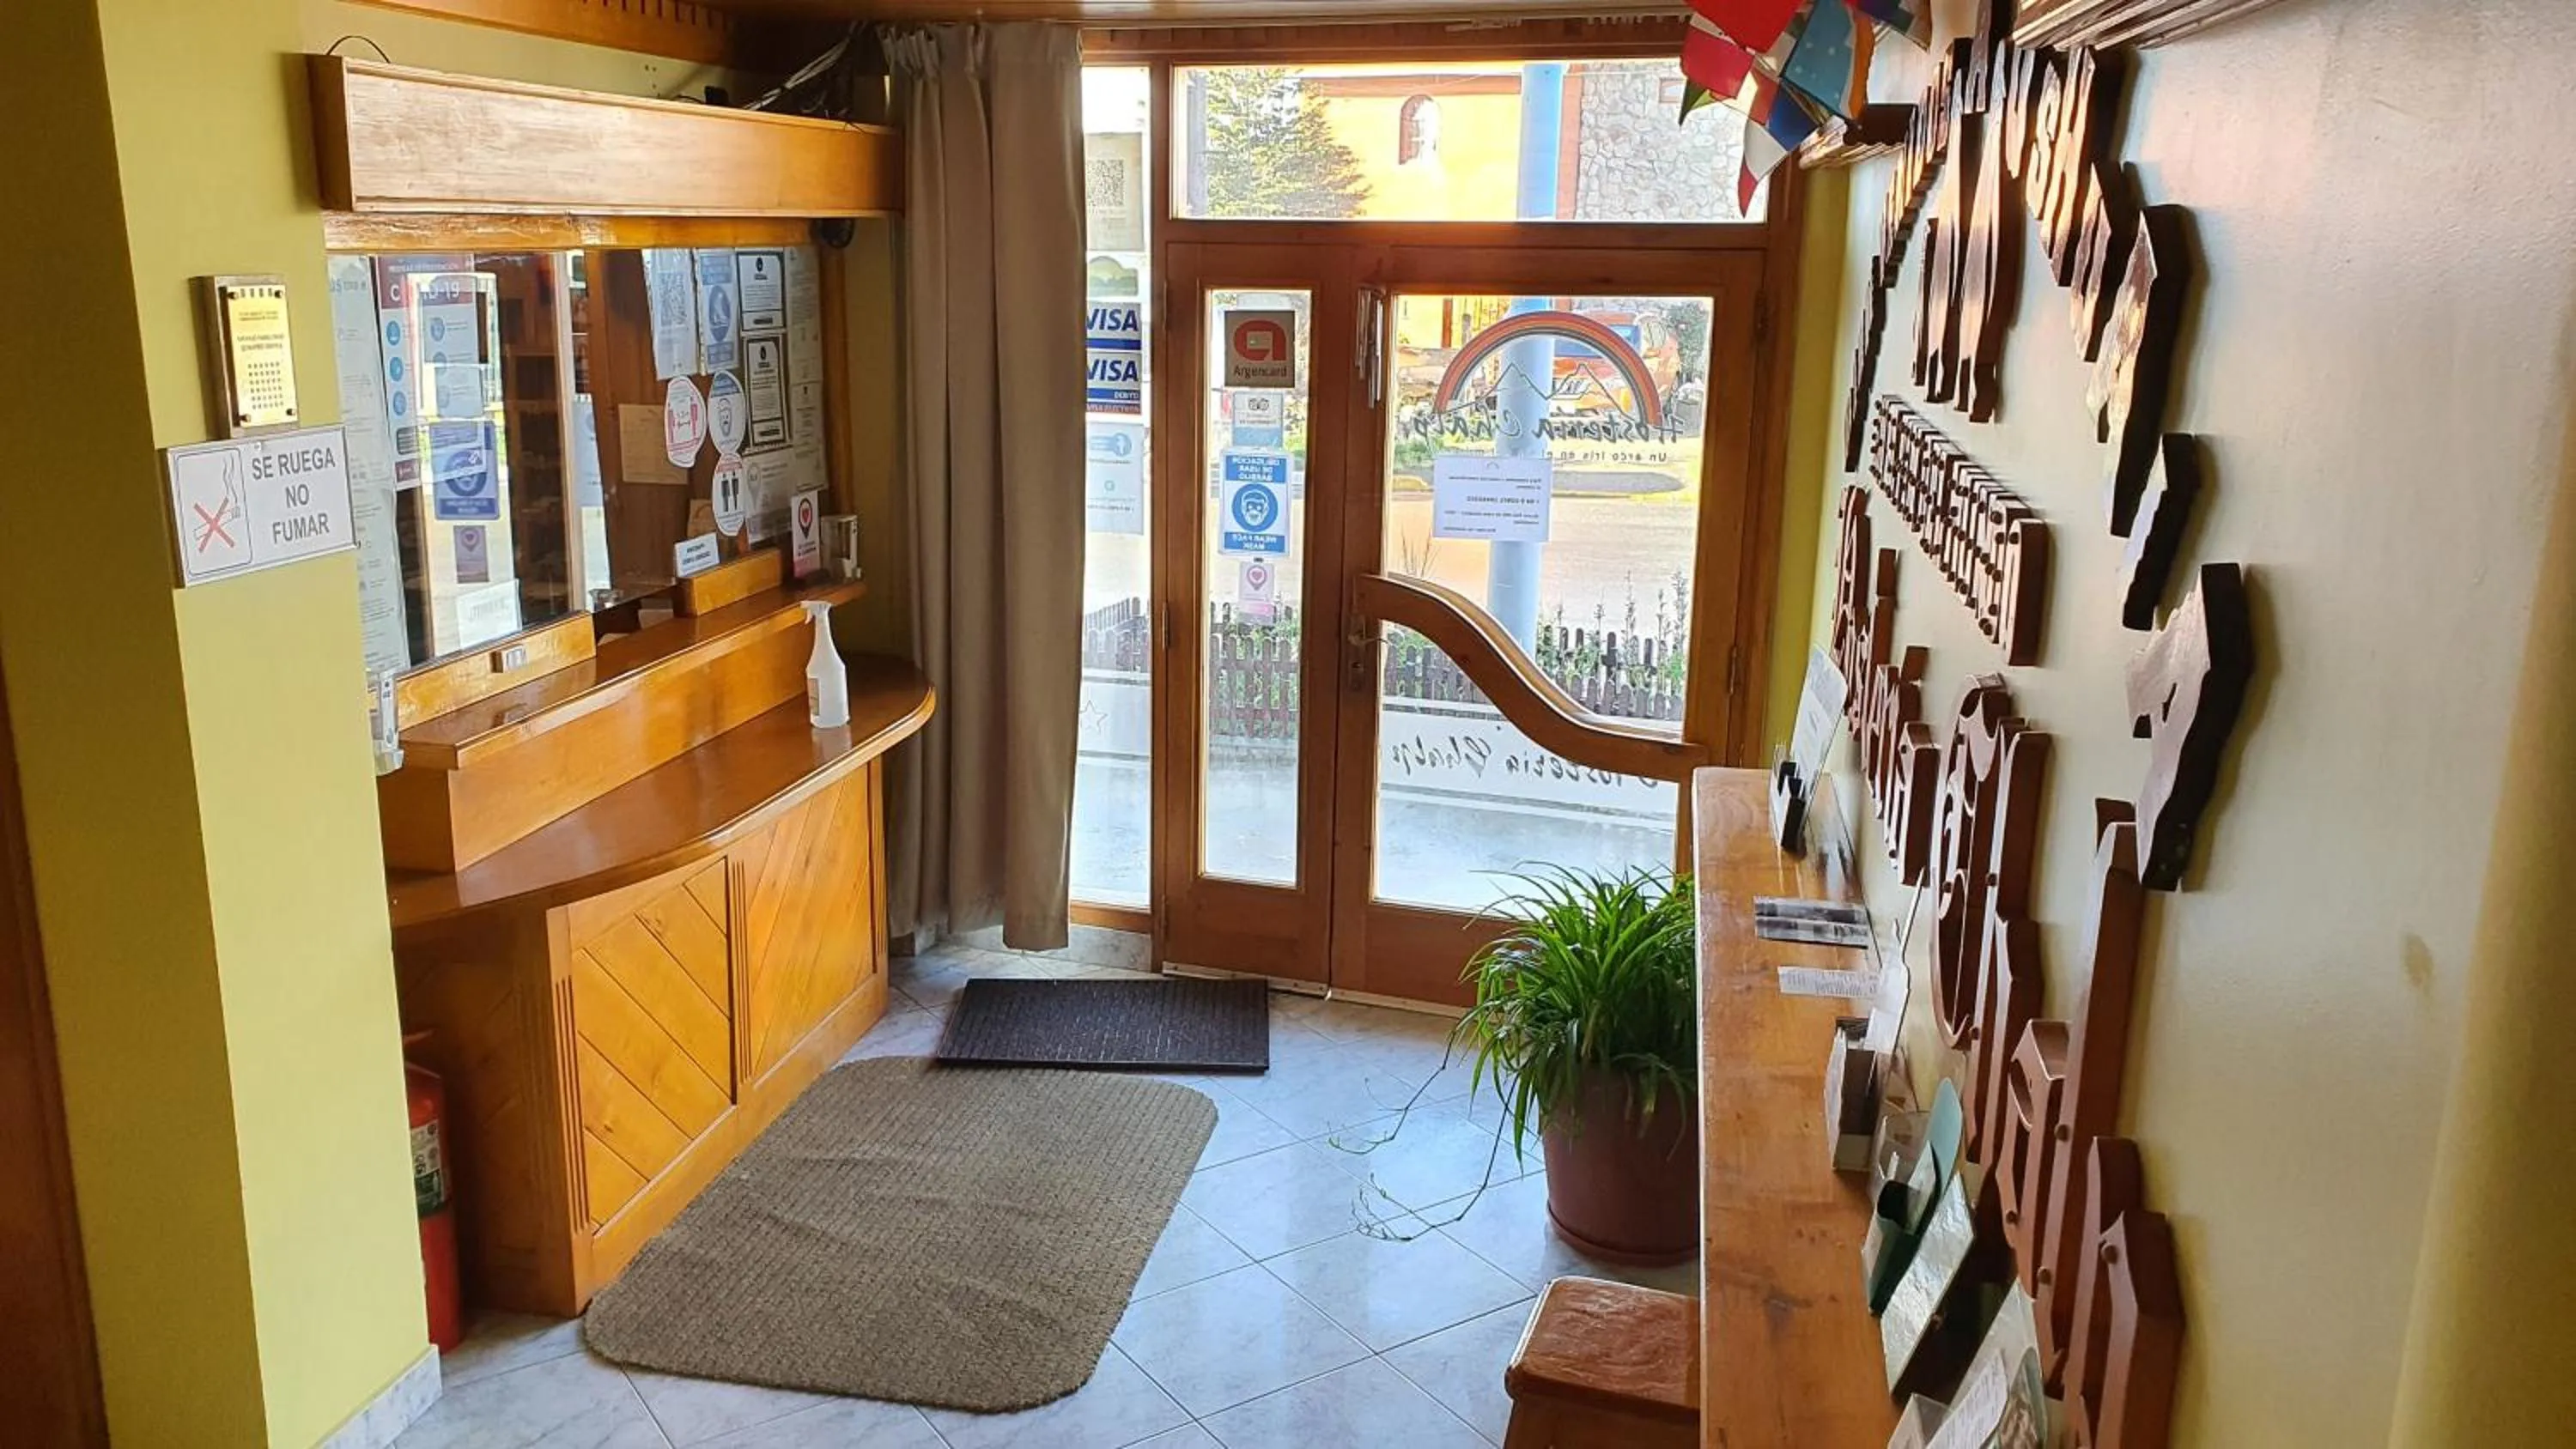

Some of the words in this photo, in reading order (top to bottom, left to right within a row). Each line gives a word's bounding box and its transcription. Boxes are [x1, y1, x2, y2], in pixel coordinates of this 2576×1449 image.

[1087, 308, 1139, 332] VISA
[1087, 359, 1139, 382] VISA
[1233, 366, 1288, 379] Argencard
[251, 454, 275, 482] SE
[277, 446, 337, 477] RUEGA
[285, 483, 310, 506] NO
[271, 512, 331, 544] FUMAR
